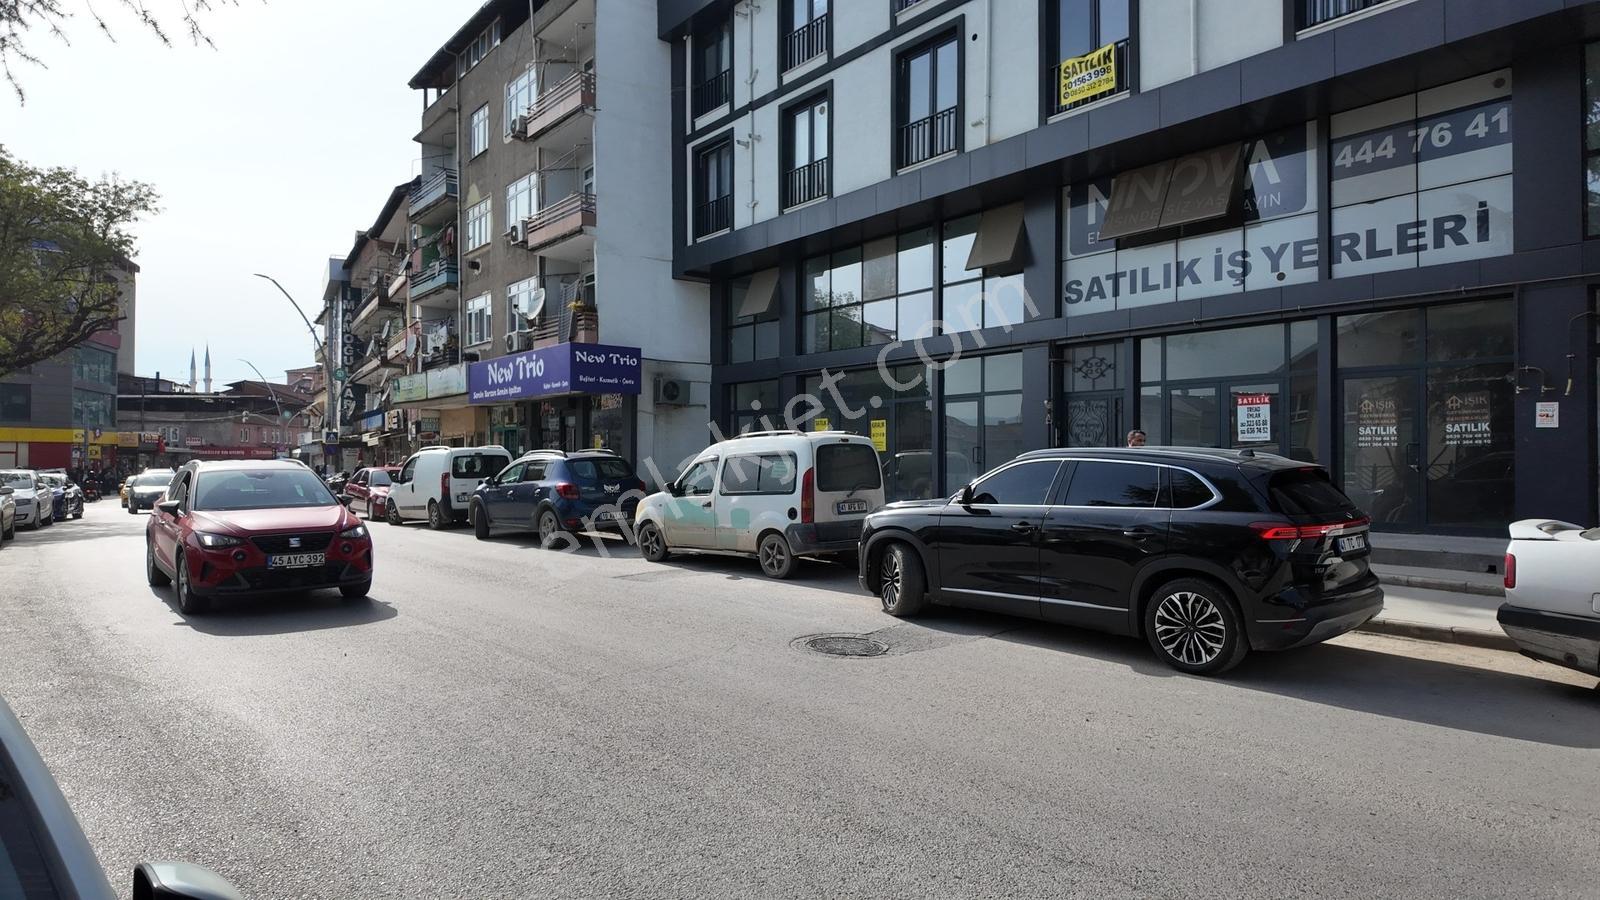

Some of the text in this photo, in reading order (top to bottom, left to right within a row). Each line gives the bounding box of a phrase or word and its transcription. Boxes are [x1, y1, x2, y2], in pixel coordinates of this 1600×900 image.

[1063, 48, 1112, 80] SATILIK
[1334, 106, 1510, 169] 444 76 41
[1064, 200, 1491, 305] SATILIK İŞ YERLERİ
[575, 351, 637, 366] New Trio
[488, 354, 544, 385] New Trio
[1238, 396, 1270, 405] SATILIK
[1358, 426, 1397, 435] SATILIK
[1446, 422, 1490, 432] SATILIK
[272, 554, 324, 565] 45 AYC 392
